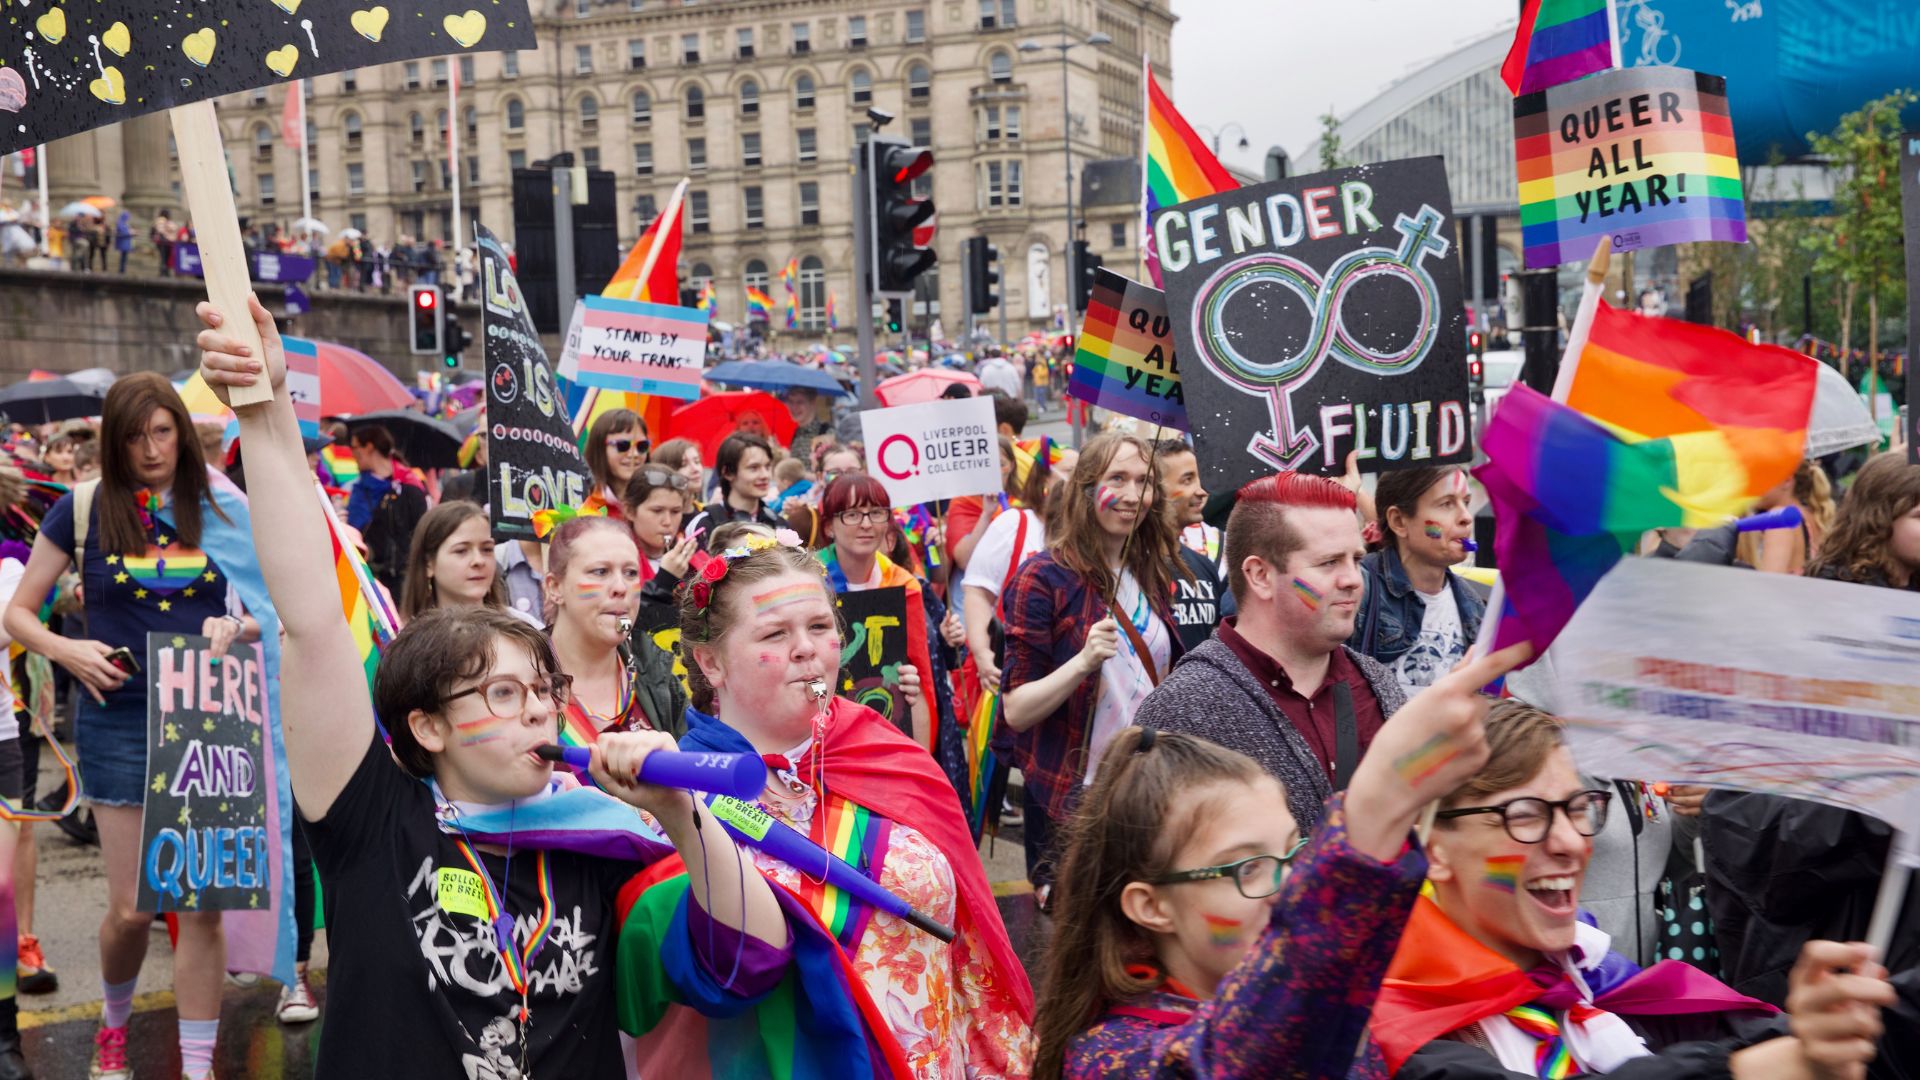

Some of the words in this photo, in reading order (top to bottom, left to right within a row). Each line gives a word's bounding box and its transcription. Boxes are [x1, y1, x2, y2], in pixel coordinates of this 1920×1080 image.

[1561, 92, 1683, 143] QUEER
[1588, 139, 1653, 179] ALL
[1575, 173, 1688, 224] YEAR!
[1154, 181, 1382, 272] GENDER
[593, 345, 632, 363] YOUR
[605, 327, 653, 344] STAND
[660, 332, 679, 347] BY
[1144, 344, 1180, 375] AL
[523, 357, 555, 418] IS
[1125, 366, 1184, 405] YEA
[923, 425, 987, 441] LIVERPOOL
[1320, 401, 1465, 466] FLUID
[927, 458, 991, 474] COLLECTIVE
[1178, 579, 1215, 600] MY
[157, 646, 262, 726] HERE
[169, 739, 257, 798] AND
[721, 795, 734, 805] TO
[735, 803, 767, 826] BREXIT
[146, 826, 270, 898] QUEER
[440, 883, 453, 893] TO
